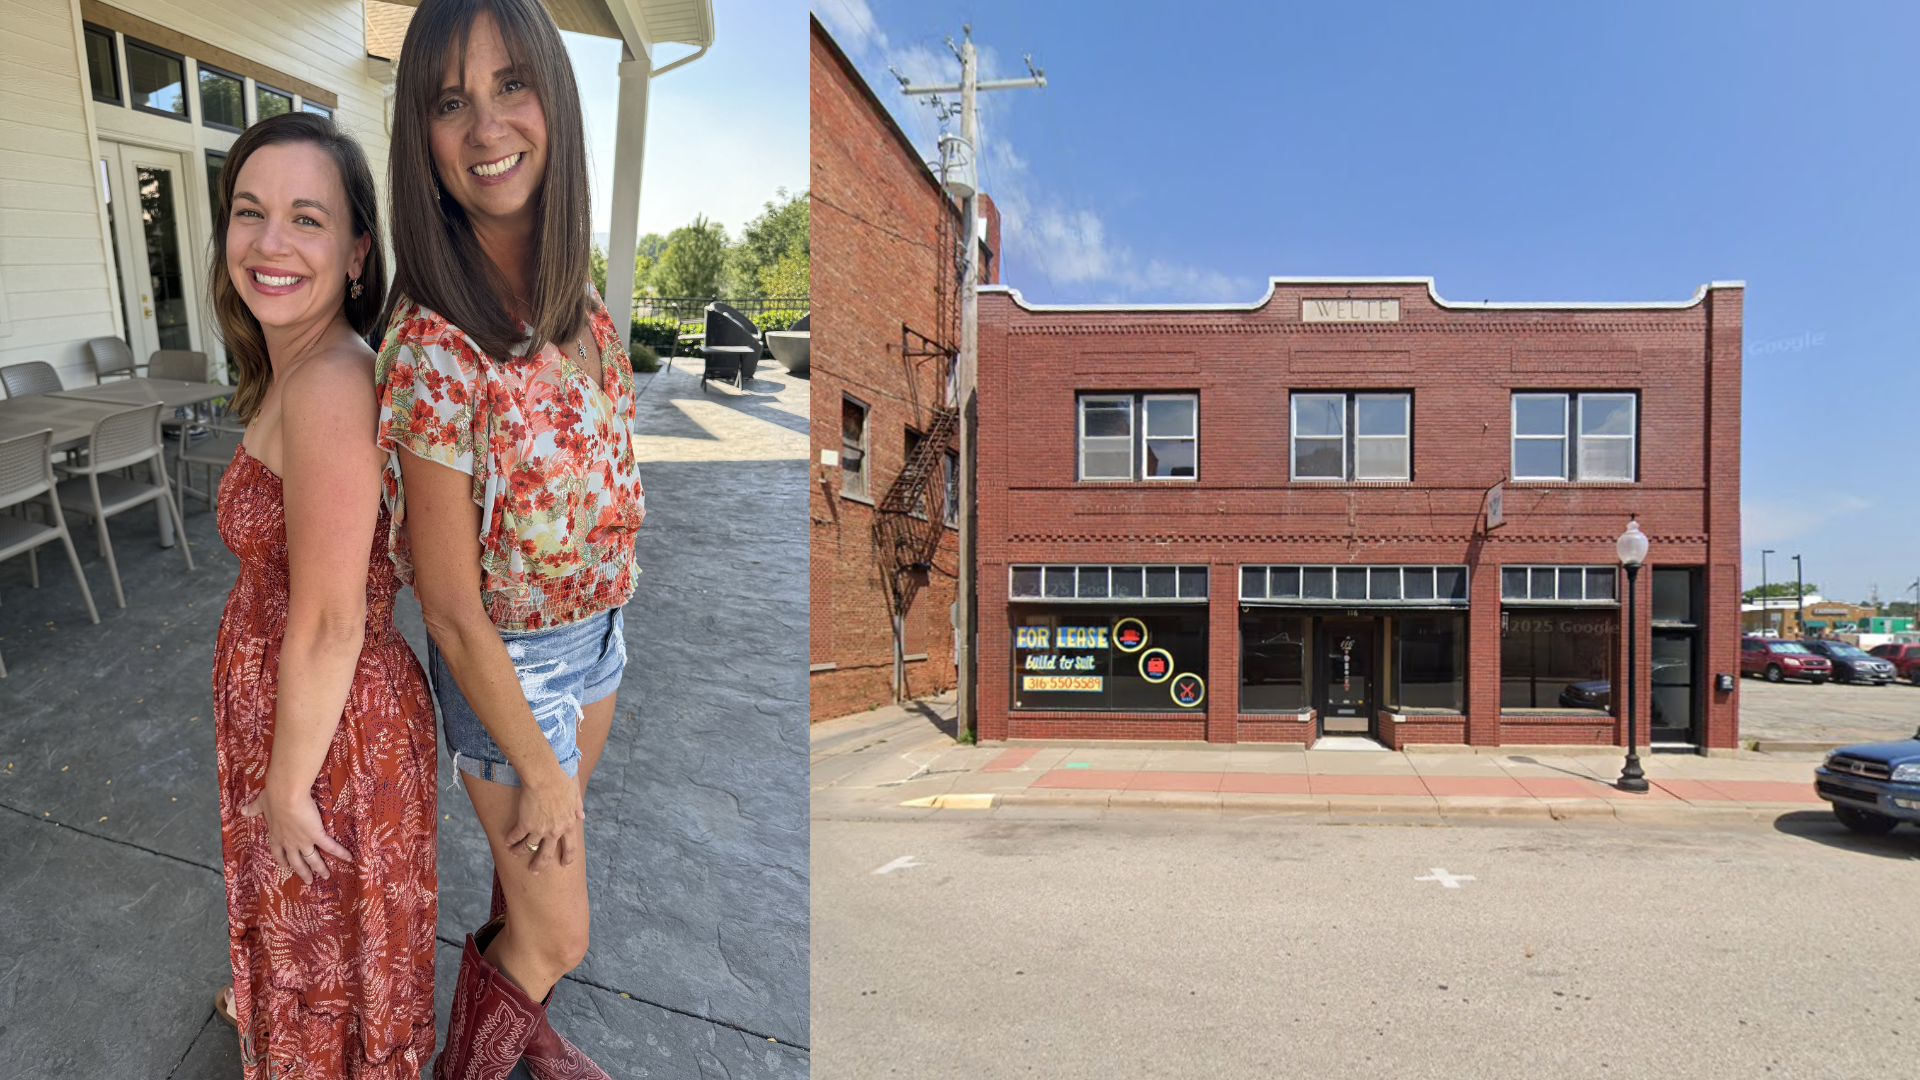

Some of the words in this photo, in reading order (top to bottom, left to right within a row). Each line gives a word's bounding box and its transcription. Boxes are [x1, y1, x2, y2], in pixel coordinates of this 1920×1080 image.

[1314, 300, 1389, 319] WELTE
[1017, 627, 1049, 648] FOR
[1056, 627, 1109, 648] LEASE
[1025, 654, 1057, 670] build
[1059, 655, 1074, 670] to
